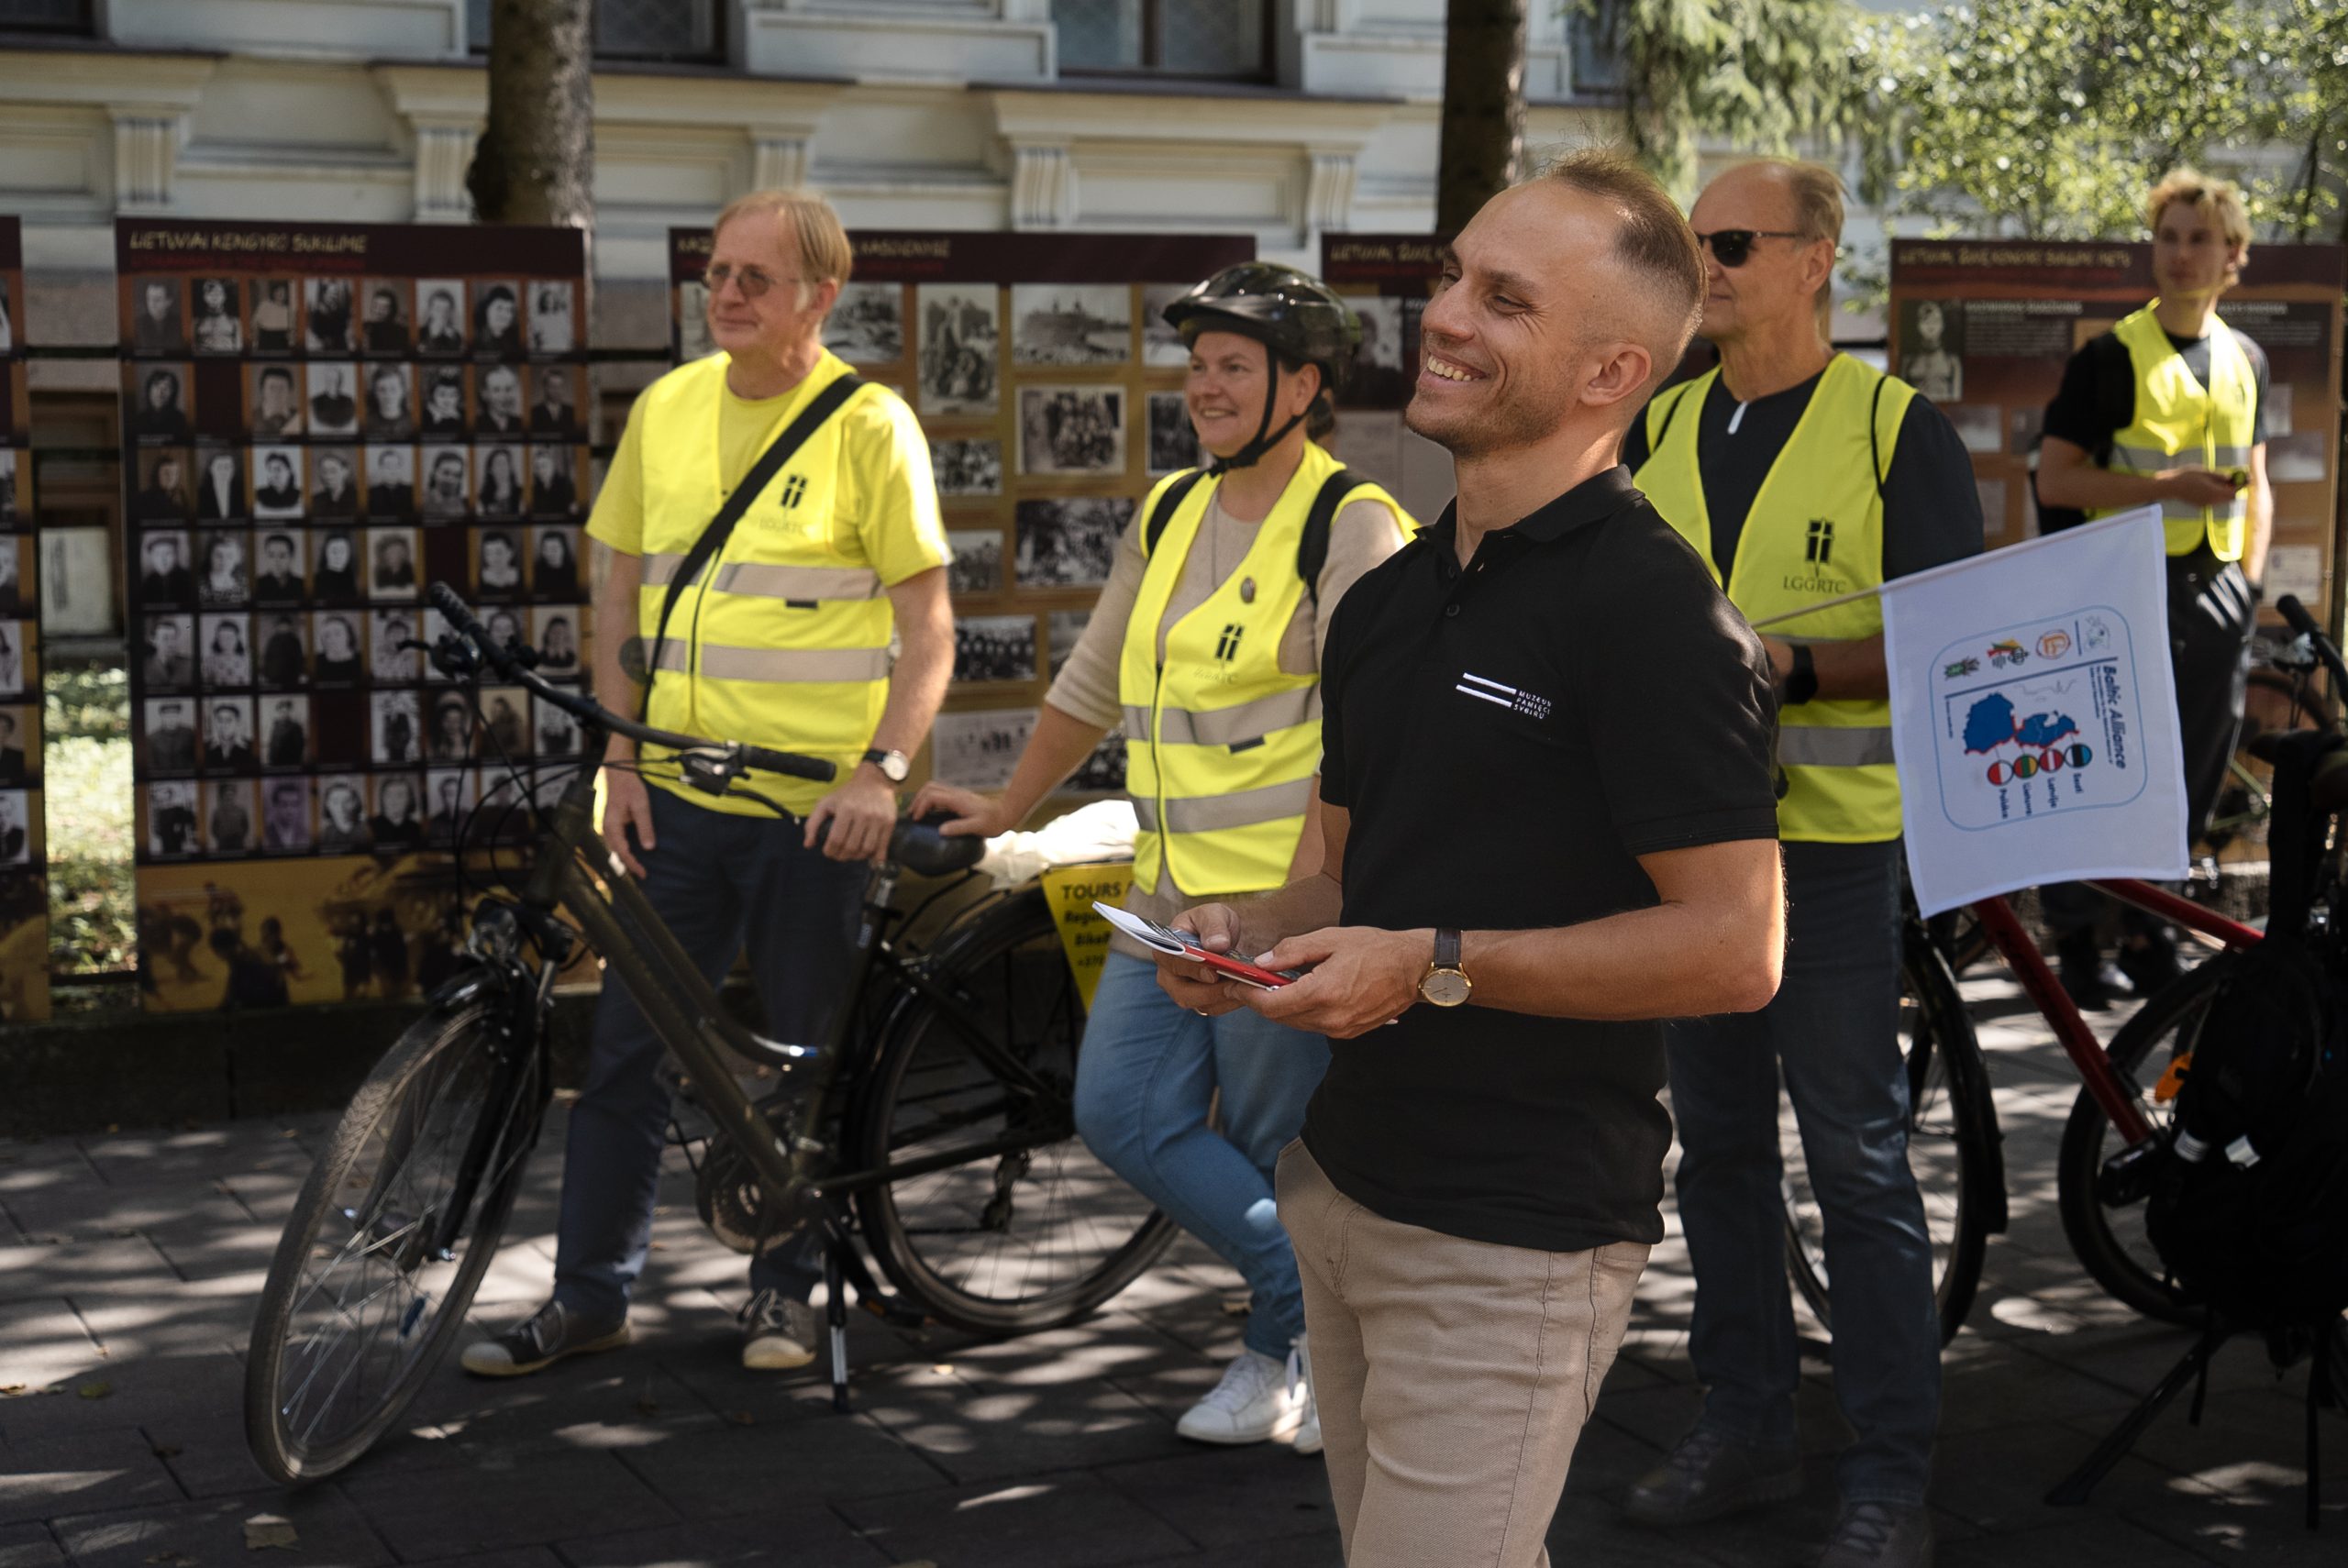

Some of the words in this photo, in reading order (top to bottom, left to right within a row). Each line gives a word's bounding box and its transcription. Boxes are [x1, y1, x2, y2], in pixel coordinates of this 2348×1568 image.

[1783, 575, 1847, 594] LGGRTC
[2102, 665, 2118, 707] Baltic
[1519, 690, 1551, 707] MUZEUM
[1513, 703, 1545, 719] SYBIRU
[2109, 709, 2127, 770] Alliance
[1060, 881, 1121, 900] TOURS
